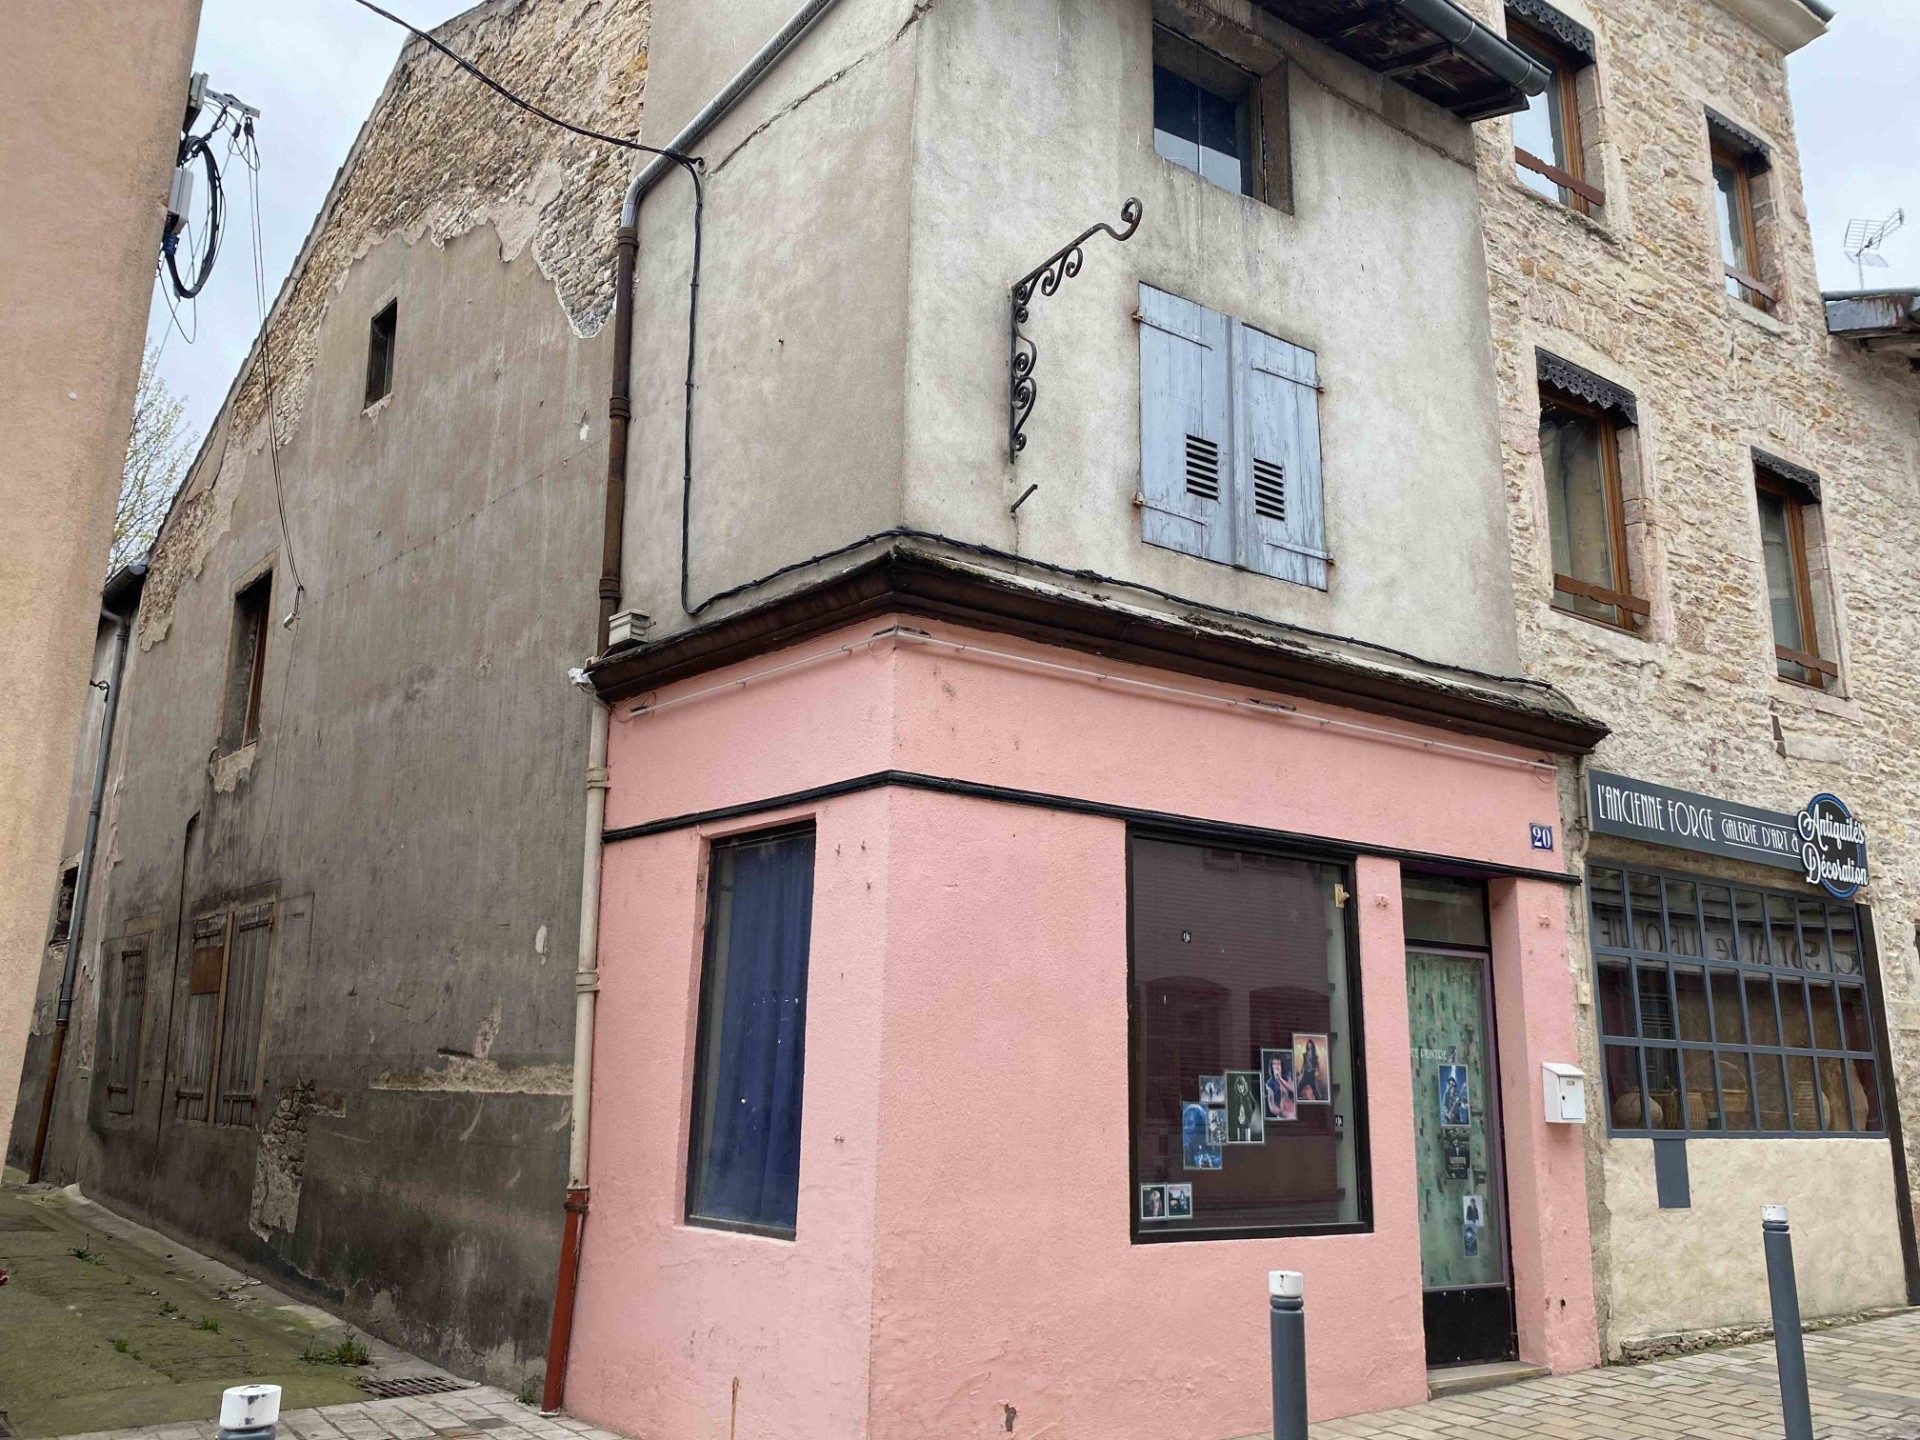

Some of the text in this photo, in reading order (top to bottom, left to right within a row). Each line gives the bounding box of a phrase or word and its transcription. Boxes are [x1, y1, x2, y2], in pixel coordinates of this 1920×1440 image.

[1532, 826, 1551, 848] 20
[1597, 783, 1666, 831] L'ANCIENNE
[1667, 800, 1716, 842] FORGE
[1721, 818, 1759, 846] GALERIE
[1761, 826, 1789, 851] D'ART
[1797, 803, 1865, 852] Antiquités
[1802, 842, 1869, 886] Décoration
